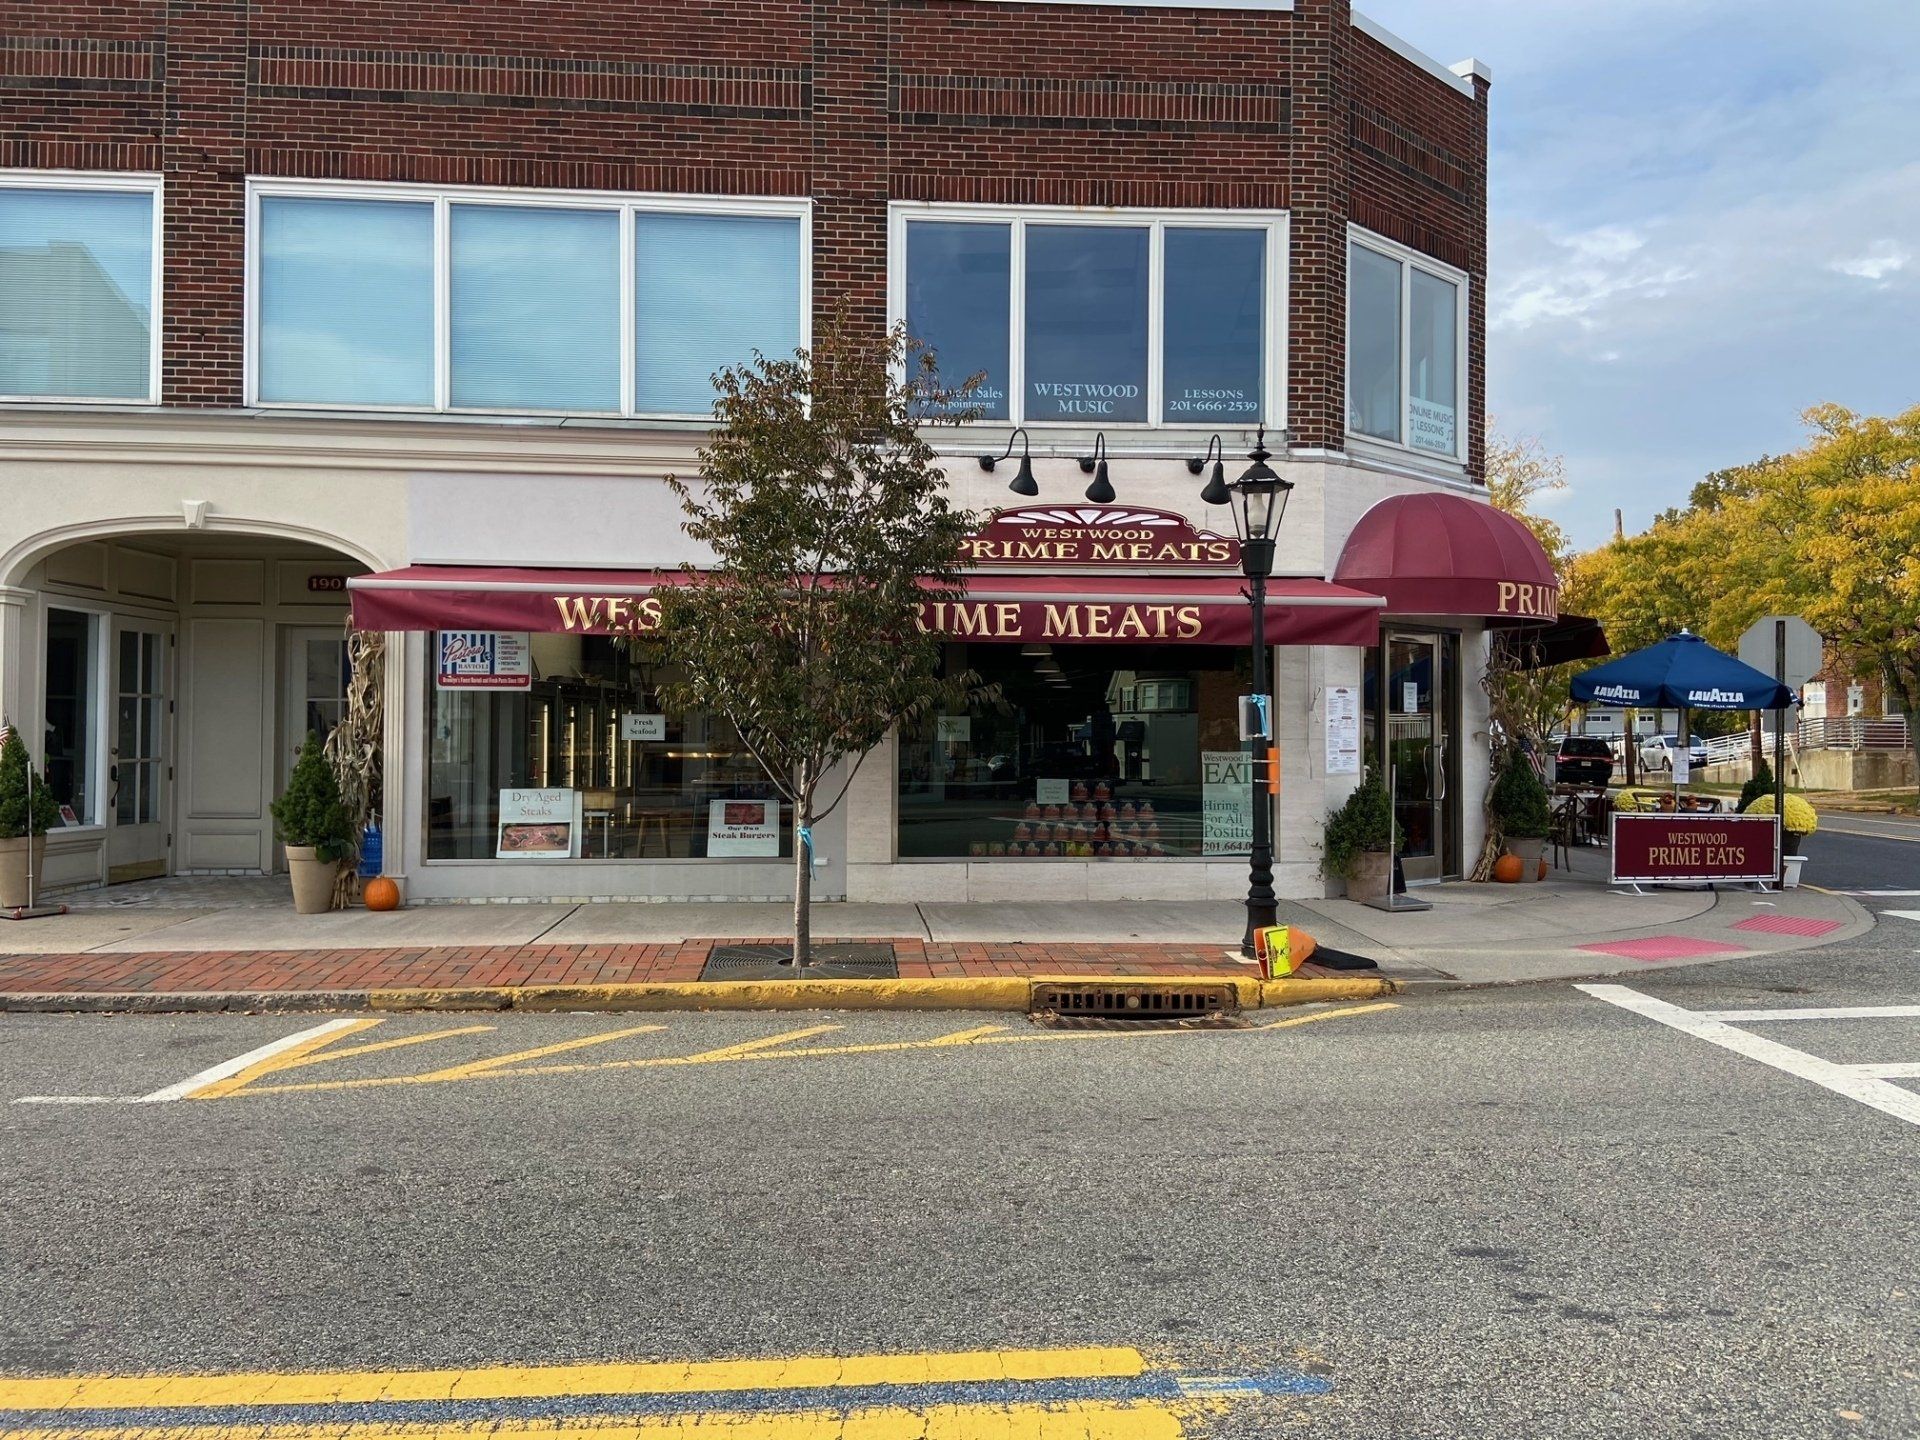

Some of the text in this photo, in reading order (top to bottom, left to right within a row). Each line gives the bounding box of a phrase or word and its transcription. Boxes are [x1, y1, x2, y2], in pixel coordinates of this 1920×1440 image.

[976, 386, 1003, 398] Sales
[1033, 383, 1139, 398] WESTWOOD
[1184, 389, 1244, 399] LESSONS
[1057, 400, 1114, 414] MUSIC
[1433, 411, 1453, 425] MUSIC
[1416, 420, 1444, 437] LESSONS
[1021, 528, 1154, 540] WESTWOOD
[1091, 542, 1231, 561] MEATS
[910, 602, 1202, 638] RIME MEATS
[444, 637, 484, 664] Pastosa
[1593, 684, 1640, 700] LAVAZZA
[1688, 687, 1744, 703] LAVAZZA
[1203, 753, 1244, 762] Westwood
[1203, 762, 1252, 784] EAT
[512, 792, 562, 803] Dry Aged
[520, 806, 552, 816] Steaks
[1203, 800, 1239, 813] Hiring
[1203, 813, 1242, 824] For All
[1203, 824, 1253, 838] Positio
[1667, 832, 1728, 845] WESTWOOD
[1203, 841, 1253, 852] 201.664.0
[1648, 847, 1745, 866] PRIME EATS
